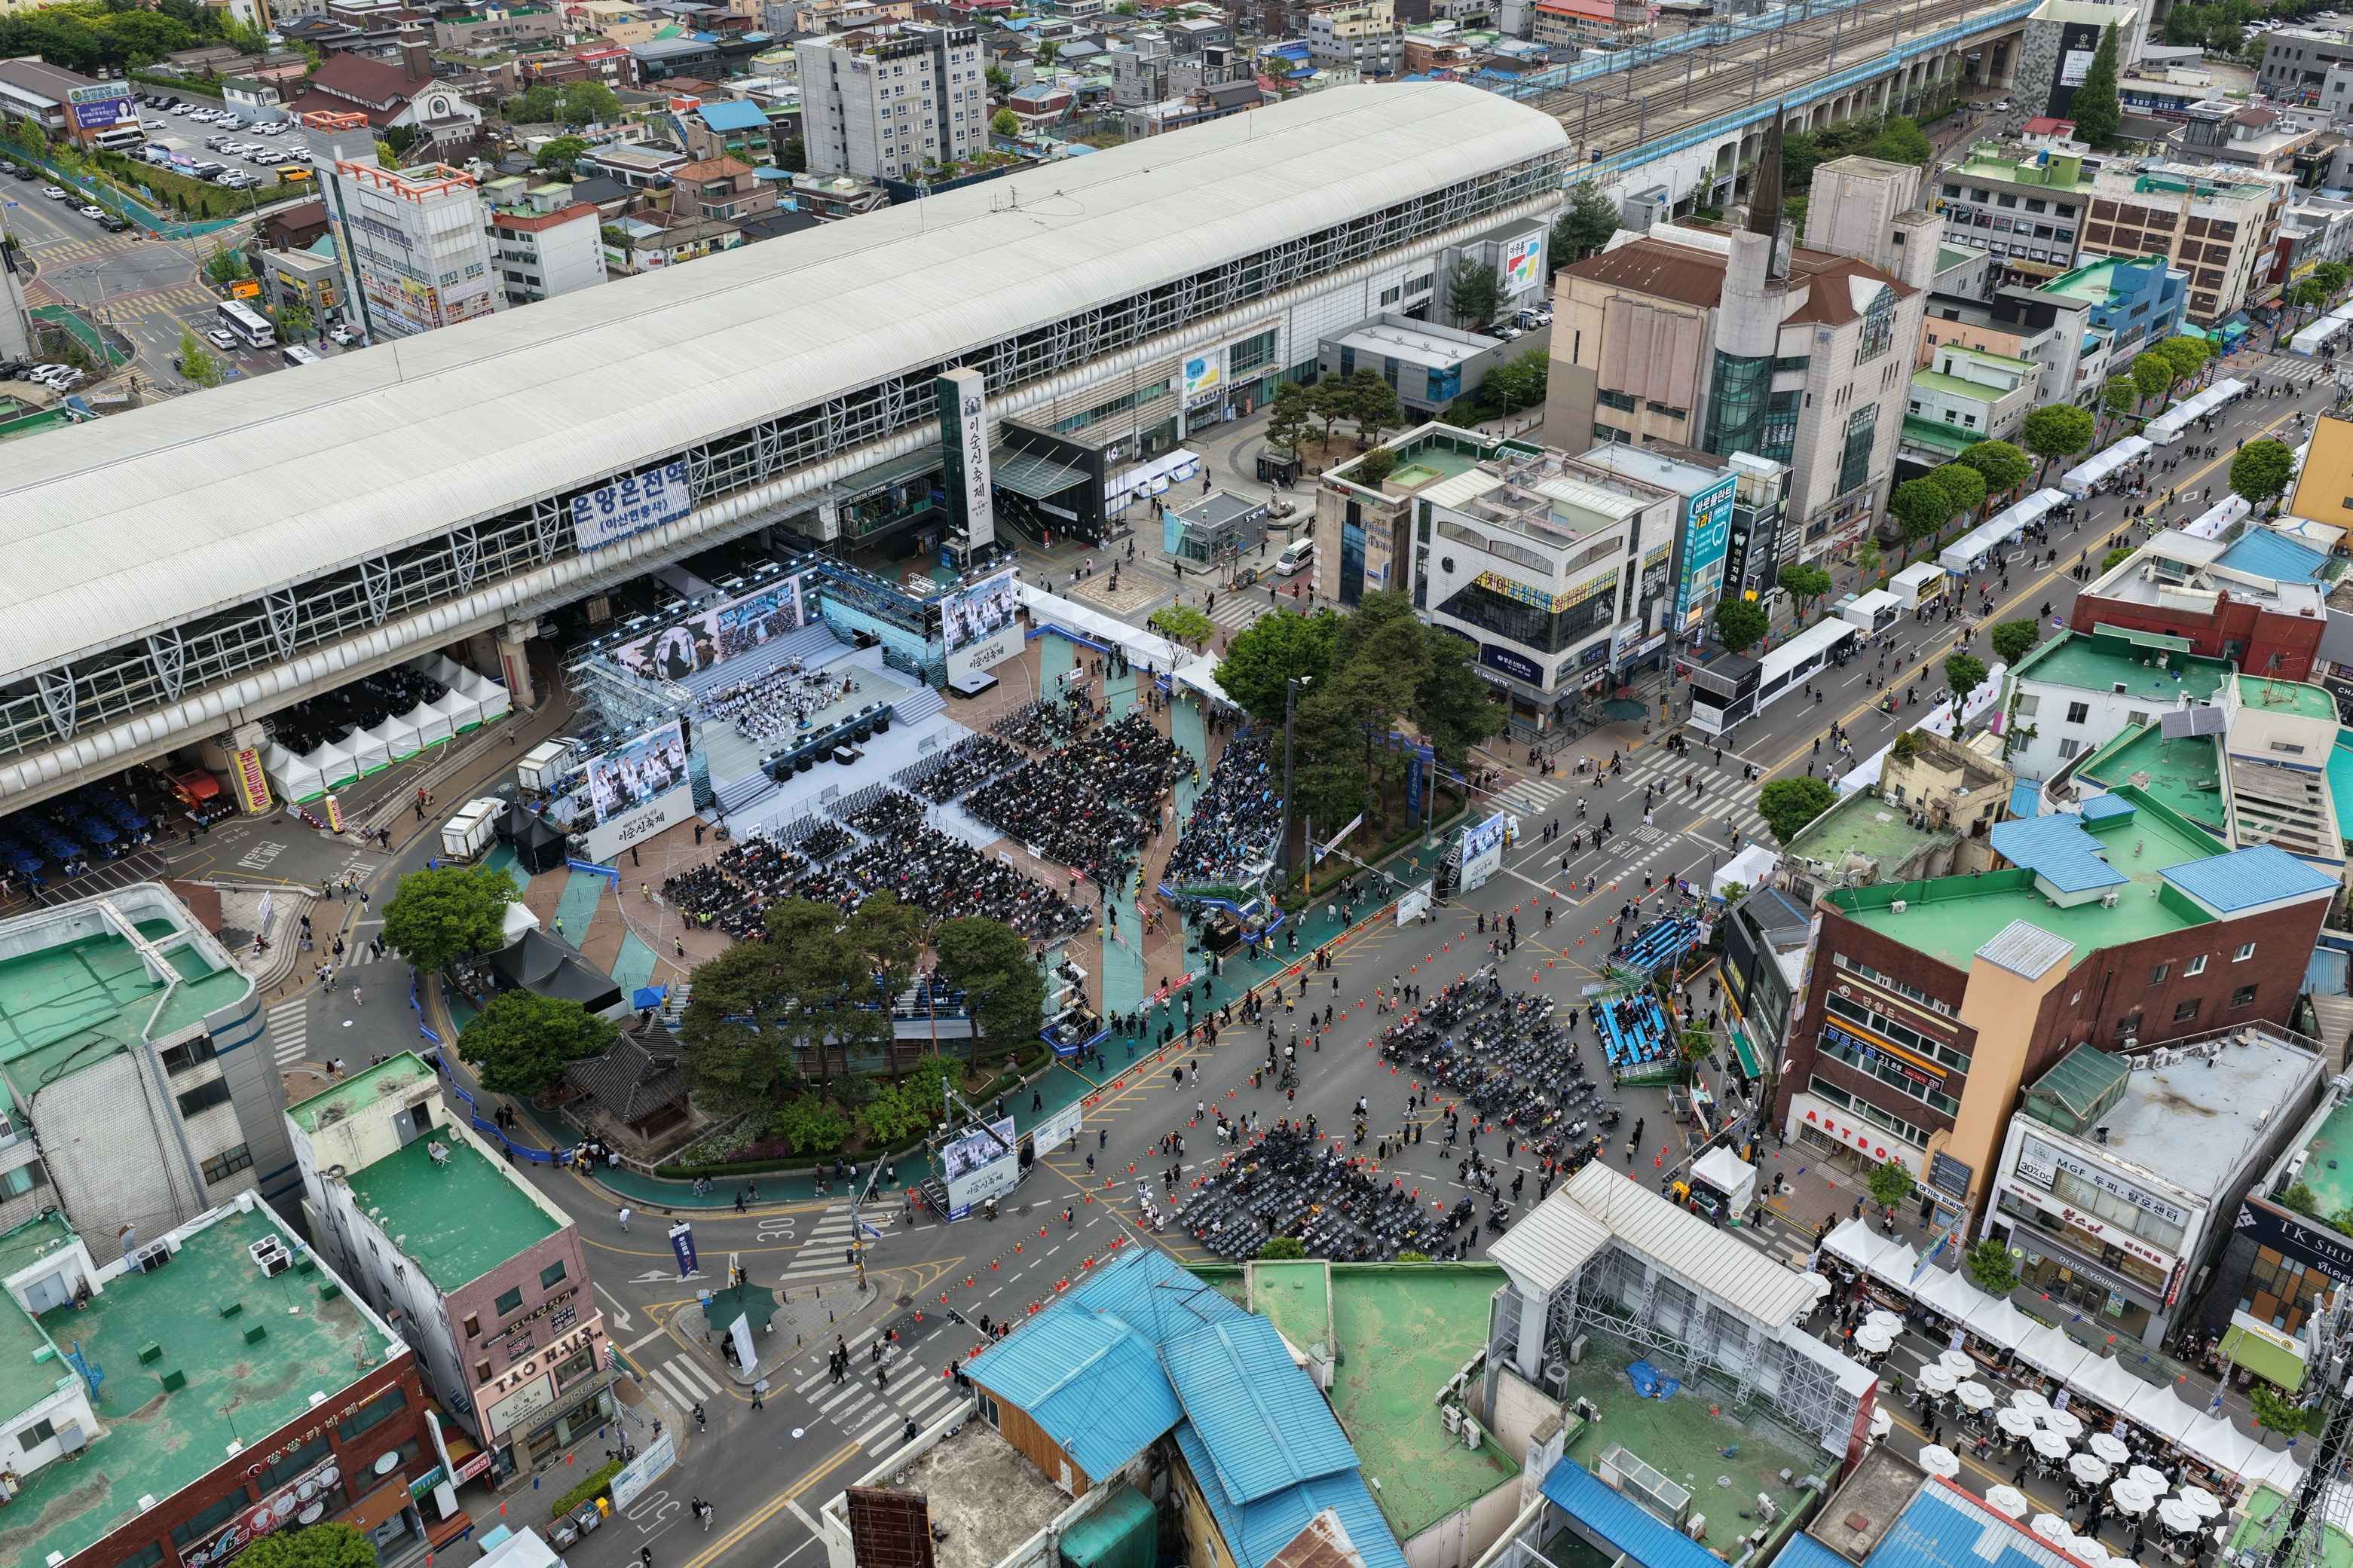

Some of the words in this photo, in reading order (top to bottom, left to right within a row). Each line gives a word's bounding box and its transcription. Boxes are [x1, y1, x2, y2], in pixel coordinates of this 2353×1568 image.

[573, 460, 689, 525] 온양온천역
[1695, 486, 1733, 515] 바로플란트
[969, 646, 1005, 669] 이순신축제
[619, 812, 666, 842] 이순신축제
[966, 1173, 1004, 1195] 이순신축제
[1919, 1184, 1941, 1200] 여기는
[2057, 1157, 2087, 1176] MGF
[2093, 1175, 2119, 1194] 두피
[2128, 1191, 2178, 1223] 탈모센터
[757, 1217, 795, 1243] 30
[2279, 1218, 2309, 1244] TK
[2058, 1255, 2088, 1274] OLIVE
[2089, 1271, 2123, 1293] YOUNG
[510, 1316, 534, 1334] 포낙
[536, 1290, 573, 1319] 보청기
[495, 1361, 537, 1394] TAO
[544, 1327, 594, 1365] HAIR
[627, 1489, 681, 1536] 50
